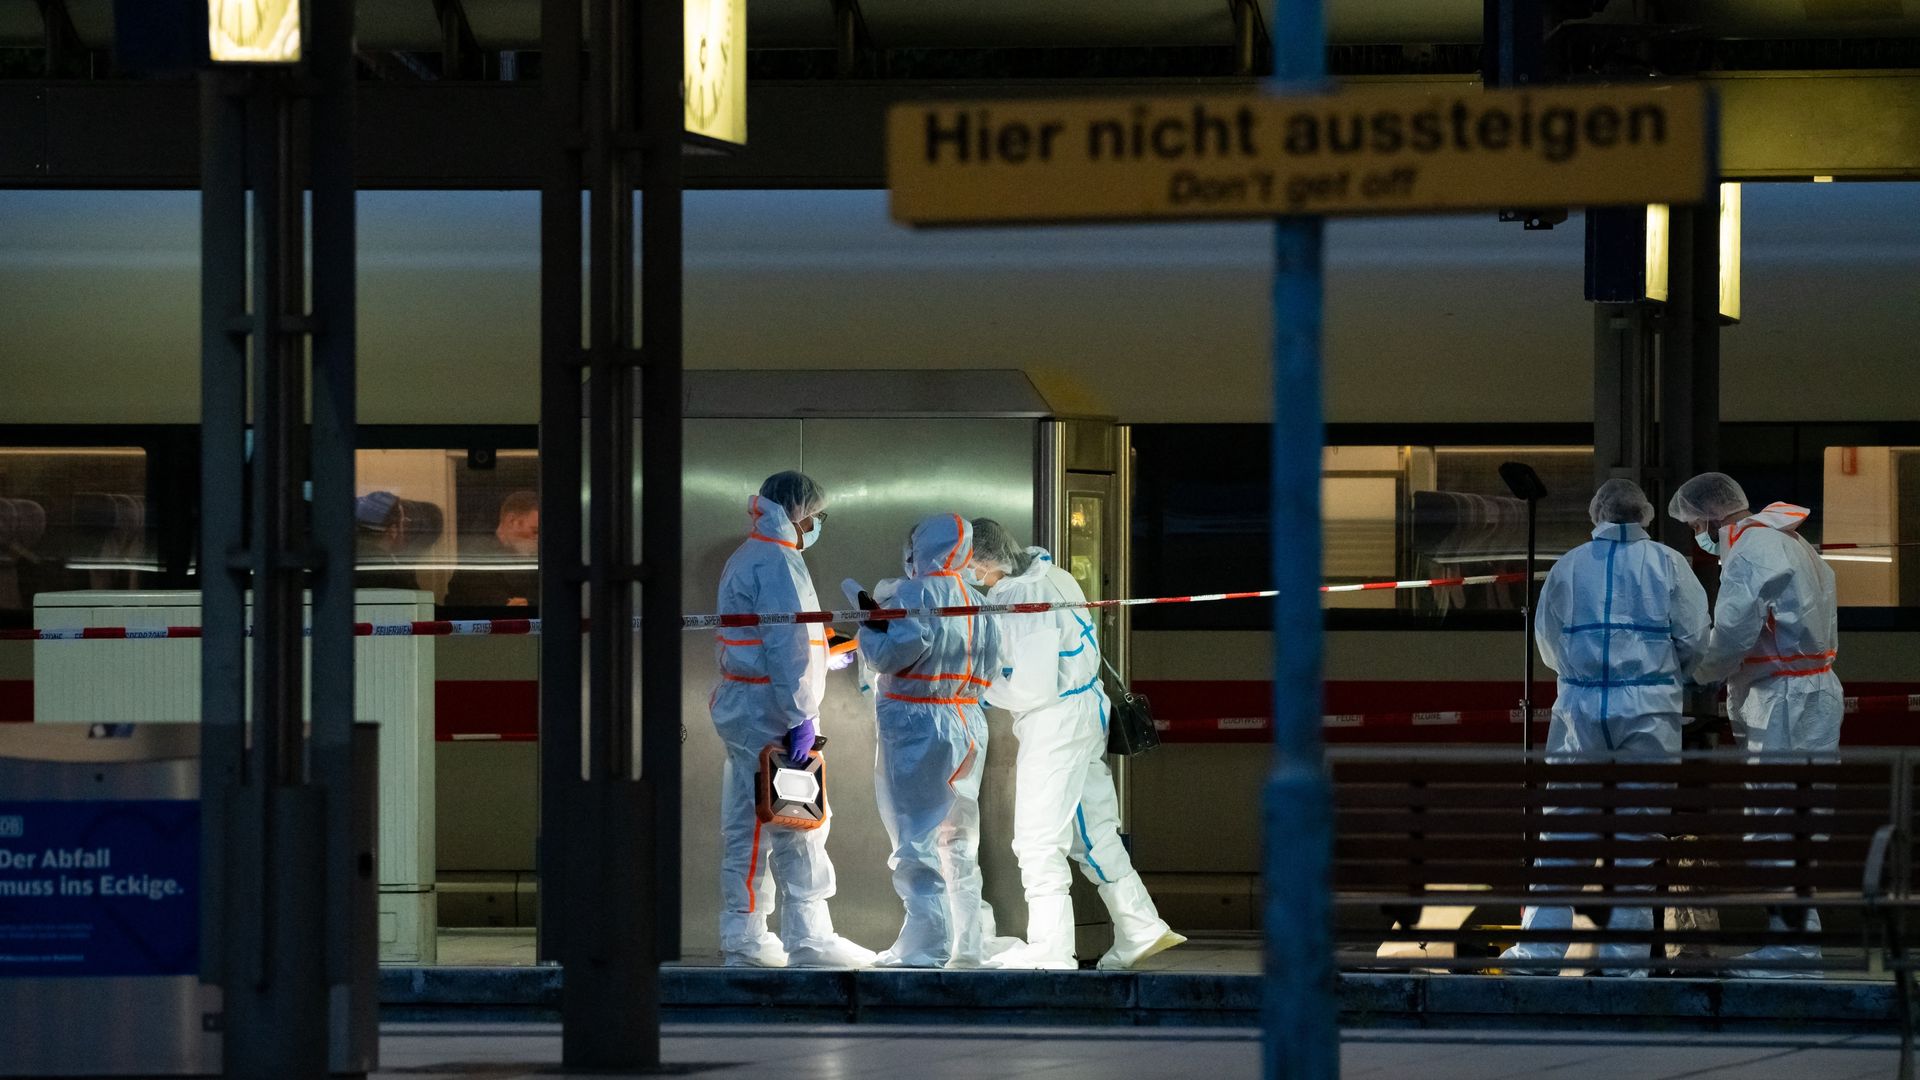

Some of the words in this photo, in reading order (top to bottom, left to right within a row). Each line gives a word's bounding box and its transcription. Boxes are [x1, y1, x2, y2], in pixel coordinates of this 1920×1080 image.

[925, 110, 1062, 164] Hier
[1087, 105, 1254, 160] nicht
[1283, 95, 1667, 163] aussteigen
[1169, 169, 1275, 205] Don't
[1287, 170, 1350, 205] get
[1361, 166, 1417, 197] off
[0, 849, 37, 869] Der
[41, 847, 111, 869] Abfall
[0, 879, 54, 896] muss
[59, 874, 94, 896] ins
[99, 873, 184, 901] Eckige.
